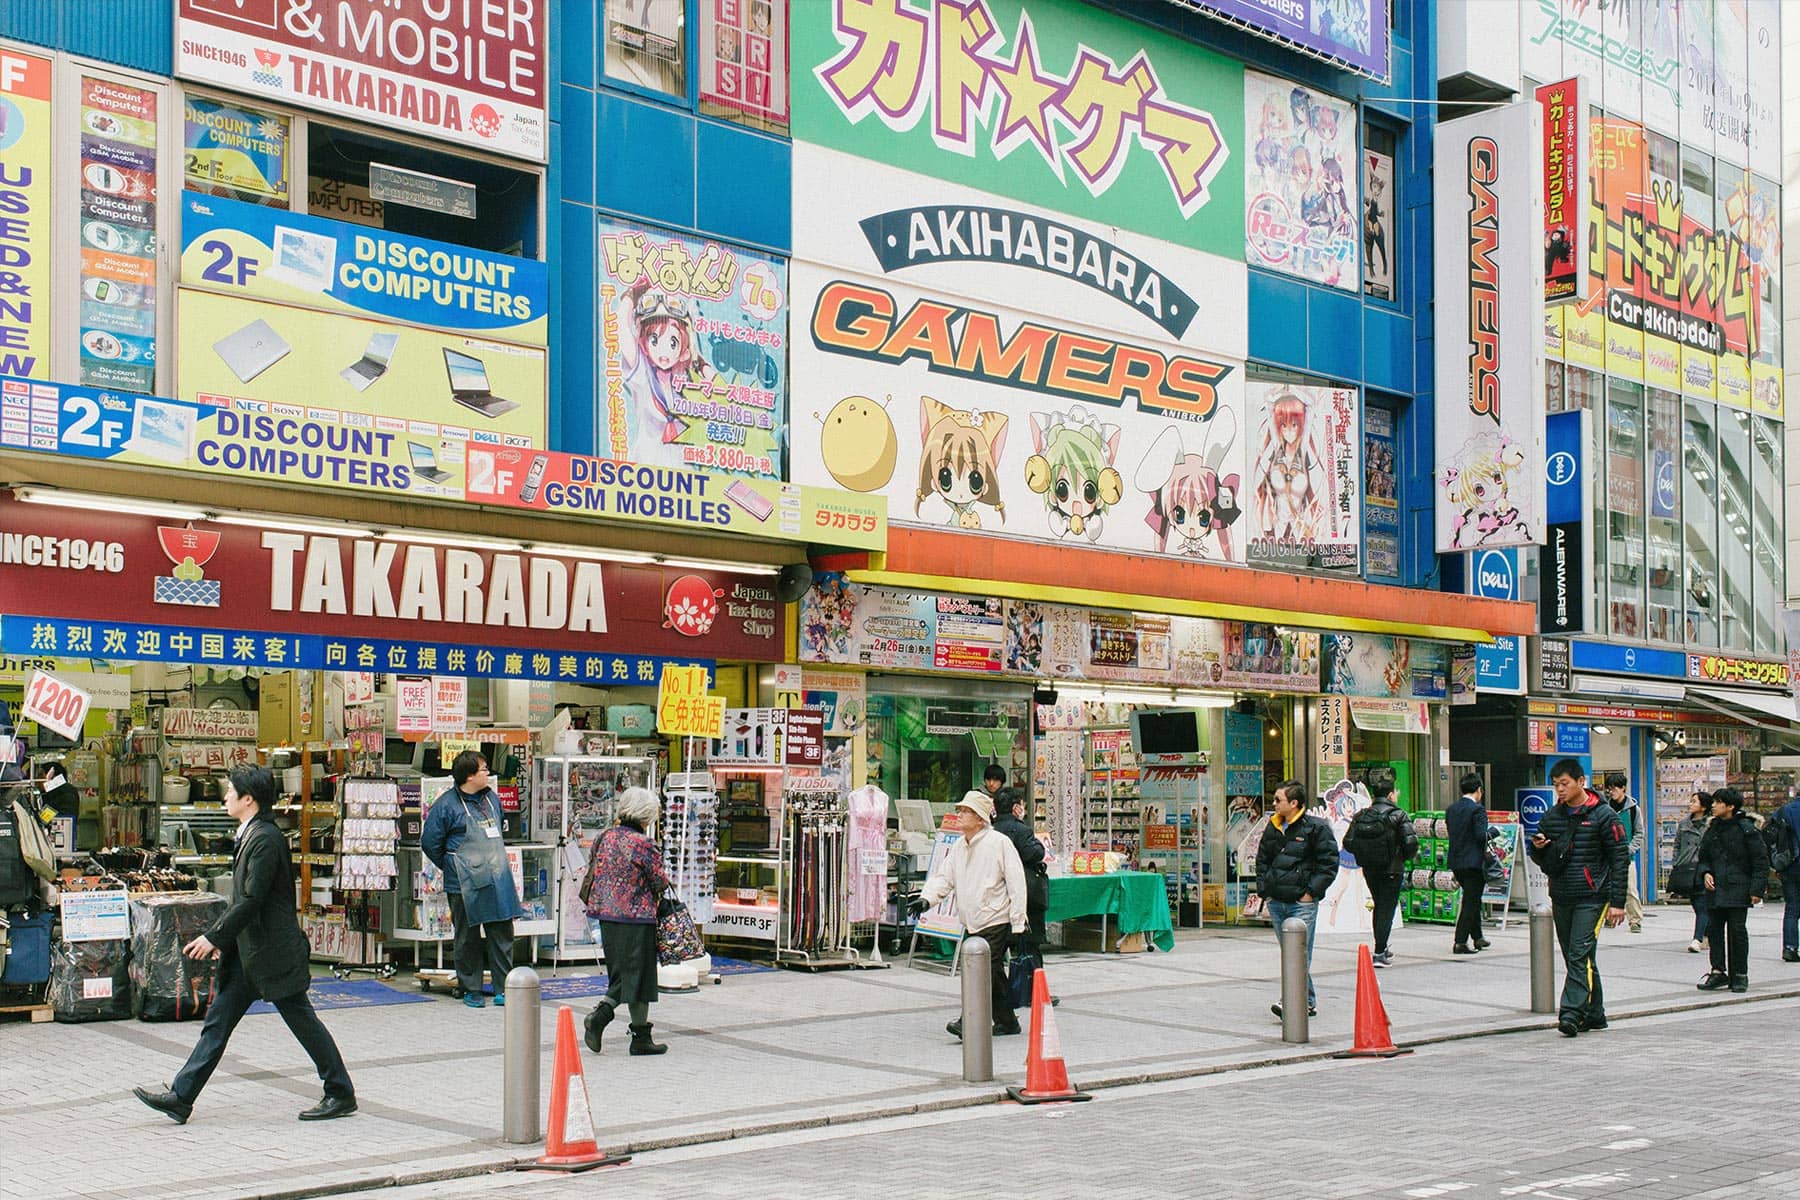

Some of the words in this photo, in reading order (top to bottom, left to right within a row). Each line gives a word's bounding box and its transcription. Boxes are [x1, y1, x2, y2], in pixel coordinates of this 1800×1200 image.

[337, 1, 536, 96] MOBILE
[94, 84, 142, 103] Discount
[182, 40, 247, 68] SINCE1946
[288, 54, 463, 132] TAKARADA
[88, 93, 148, 114] Computers
[184, 109, 252, 137] DISCOUNT
[209, 129, 281, 157] COMPUTERS
[1548, 104, 1564, 224] カードキングダム
[89, 204, 148, 223] Computers
[95, 196, 143, 213] Discount
[308, 191, 384, 218] MPUTER
[201, 239, 260, 286] 2F
[355, 235, 515, 288] DISCOUNT
[908, 211, 1163, 320] AKIHABARA
[339, 263, 532, 320] COMPUTERS
[1467, 135, 1501, 426] GAMERS
[810, 280, 1235, 421] GAMERS
[236, 400, 266, 412] NEC
[273, 407, 303, 416] SONY
[1161, 408, 1207, 422] ANIBRO
[61, 396, 124, 448] 2F
[217, 408, 395, 458] DISCOUNT
[475, 432, 499, 443] DELL
[197, 440, 411, 490] COMPUTERS
[571, 457, 710, 497] DISCOUNT
[1555, 455, 1564, 482] DELL
[544, 482, 606, 511] GSM
[616, 493, 732, 525] MOBILES
[816, 510, 878, 532] タカラダ
[1251, 536, 1317, 558] 2016.1.26
[261, 531, 608, 633] TAKARADA
[1482, 572, 1510, 590] DELL
[1555, 528, 1568, 618] ALIENWARE
[731, 583, 774, 602] Japan.
[726, 601, 775, 621] Tax-free
[744, 619, 774, 639] Shop
[31, 622, 301, 664] 热烈欢迎中国来客!
[326, 642, 713, 684] 向各位提供价廉物美的免税。
[1480, 659, 1490, 672] 2F
[1717, 657, 1788, 684] カードキングダム
[31, 676, 83, 728] 1200
[403, 686, 425, 698] FREE
[404, 697, 426, 708] Wi-Fi
[772, 710, 785, 723] 3F
[803, 701, 835, 714] nionPay
[193, 723, 256, 737] Welcome
[1320, 699, 1330, 761] エスカレーター
[806, 747, 820, 757] 3F
[1523, 805, 1545, 814] DELL
[708, 915, 756, 927] OMPUTER
[758, 918, 772, 931] 3F
